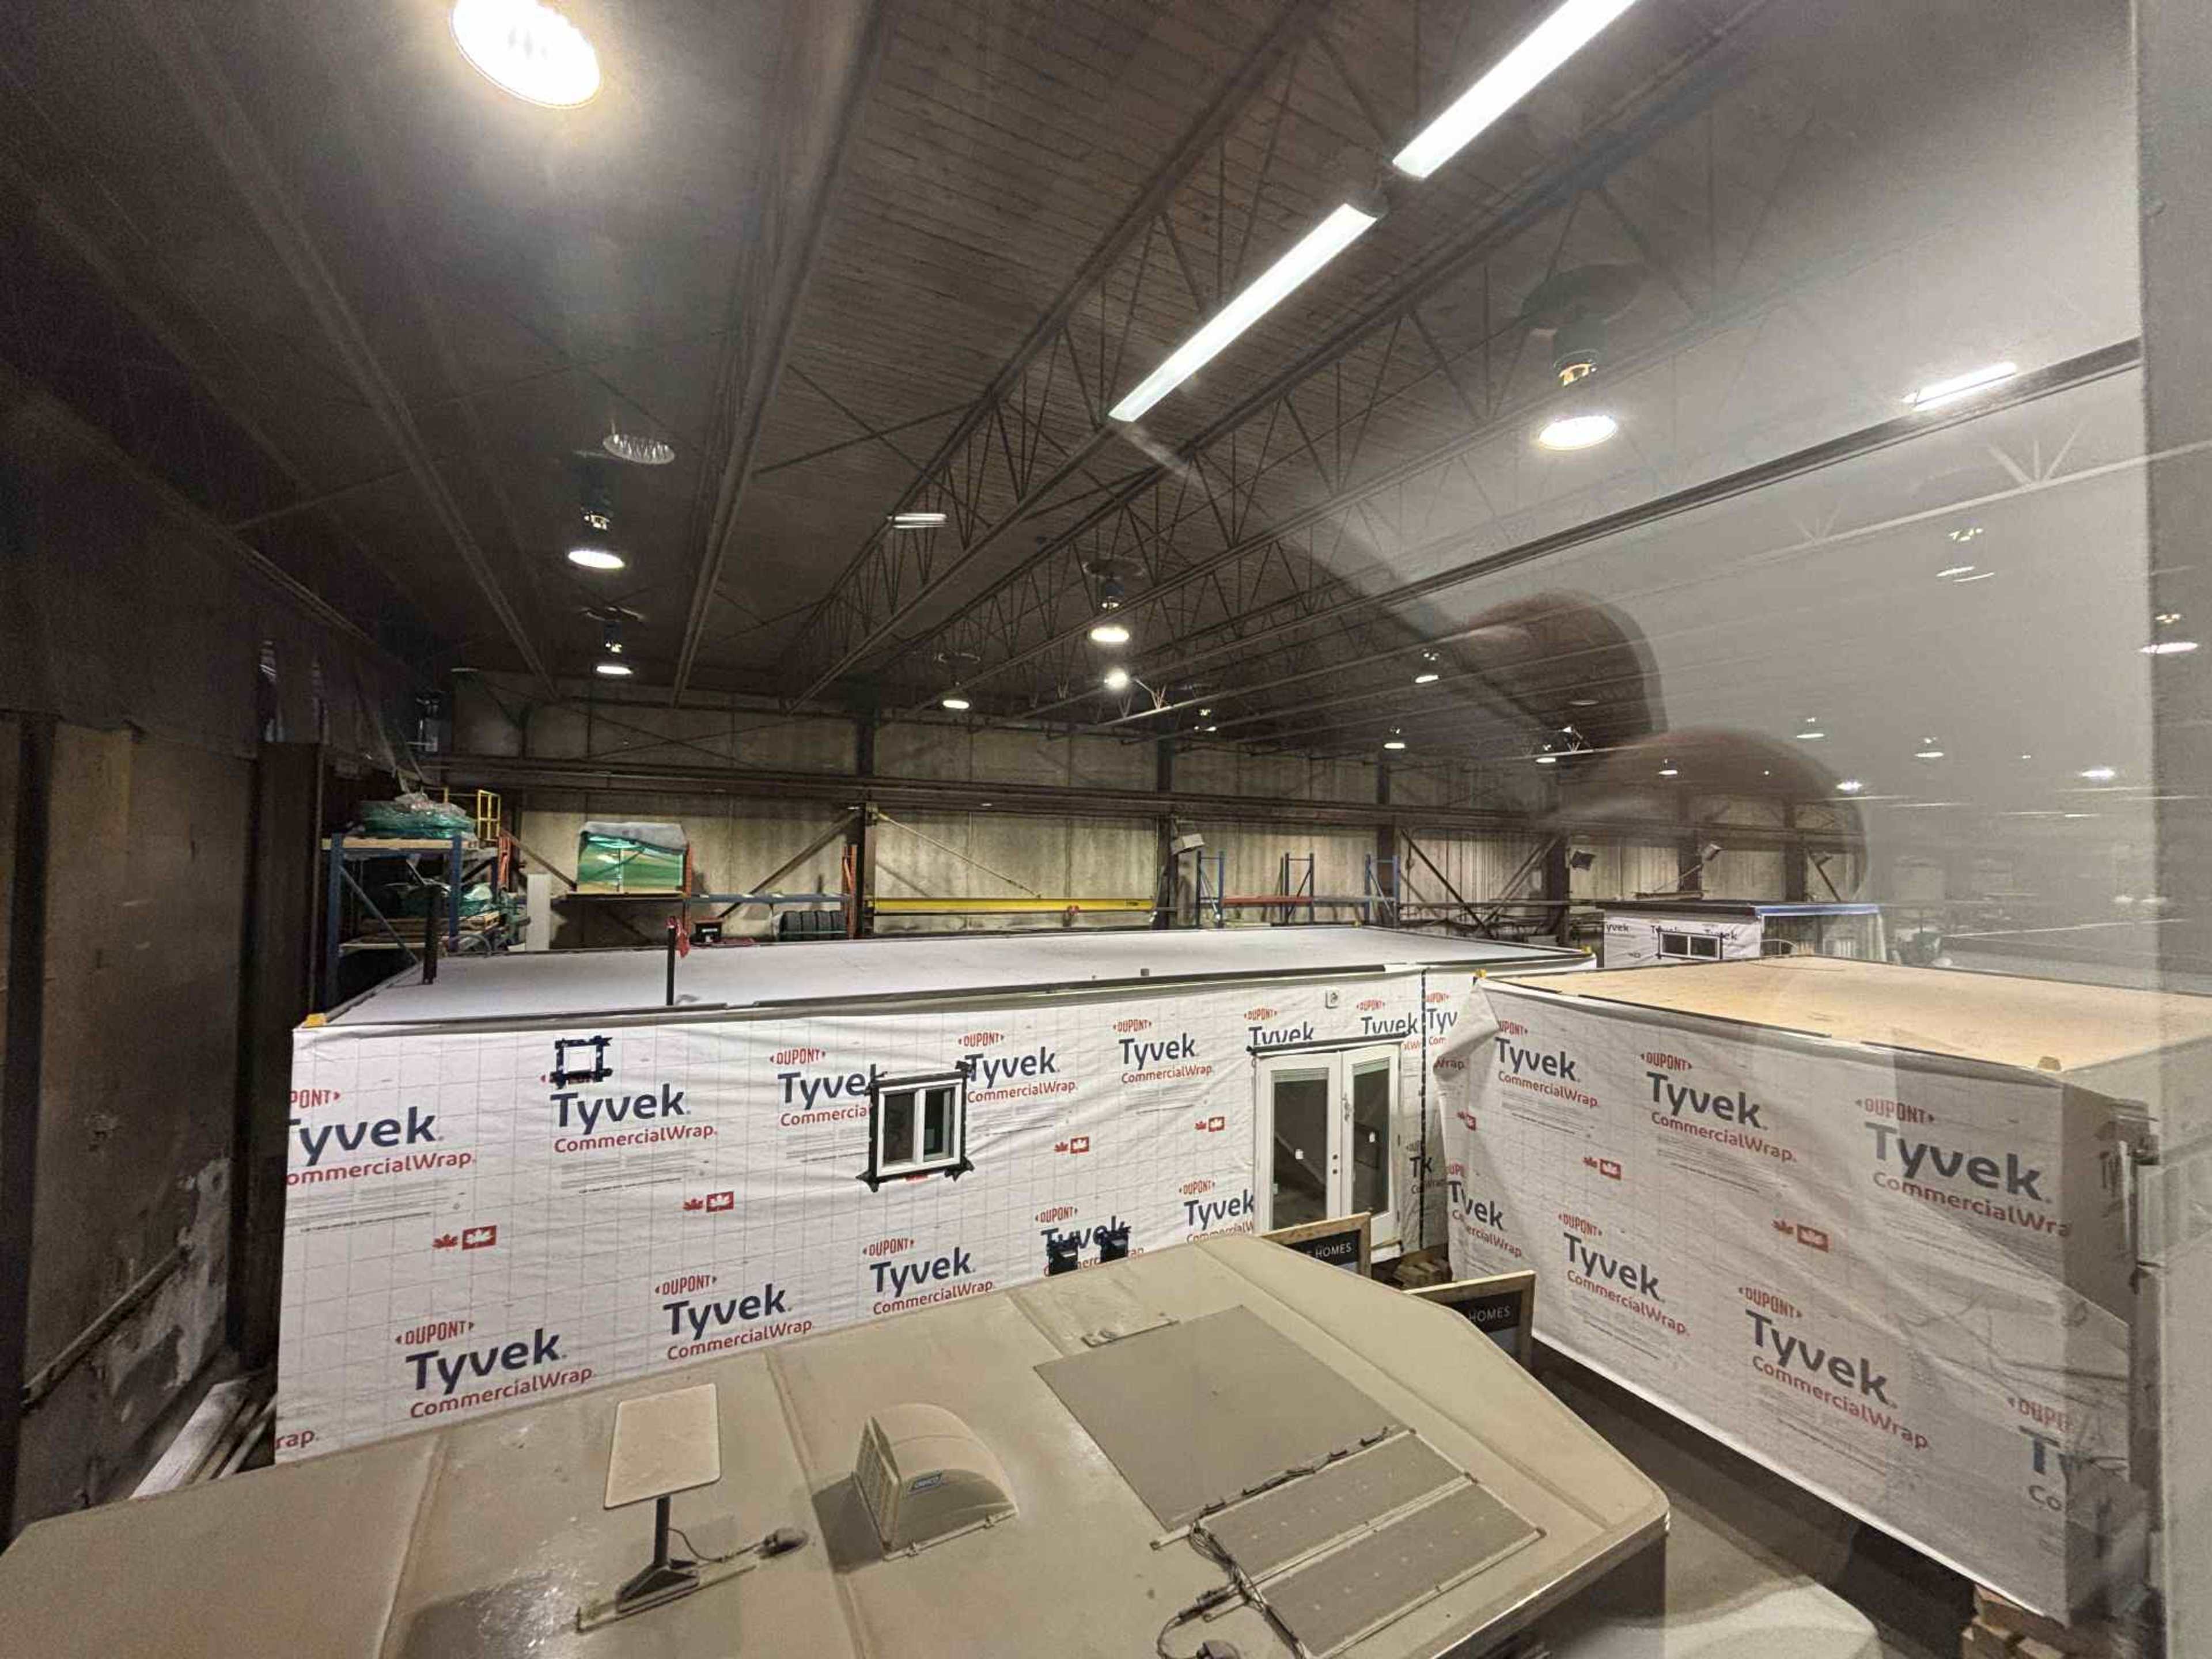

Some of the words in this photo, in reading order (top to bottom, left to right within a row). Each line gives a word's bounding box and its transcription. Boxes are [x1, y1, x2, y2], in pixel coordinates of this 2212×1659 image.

[1118, 1020, 1148, 1032] DUPONT
[1248, 1008, 1273, 1020] DUPONT
[777, 1048, 820, 1065] DUPONT
[964, 1032, 999, 1047] DUPONT
[1119, 1033, 1196, 1070] Tyvek
[965, 1047, 1055, 1089] Tyvek
[1122, 1063, 1212, 1084] CommercialWrap
[1495, 1036, 1576, 1081] Tyvek
[1646, 1052, 1687, 1071] DUPONT
[968, 1081, 1075, 1103] CommercialWrap
[1498, 1071, 1598, 1108] CommercialWrap
[1646, 1071, 1760, 1128] Tyvek
[550, 1084, 685, 1135] Tyvek
[781, 1105, 868, 1127] Commercia
[1865, 1099, 1927, 1124] DUPONT
[554, 1125, 714, 1152] CommercialWrap
[1652, 1112, 1793, 1163] CommercialWrap
[1865, 1122, 2042, 1202] Tyvek
[1183, 1180, 1211, 1195] DUPONT
[1041, 1206, 1073, 1222] DUPONT
[1184, 1189, 1253, 1230] Tyvek
[1563, 1213, 1598, 1236] DUPONT
[869, 1238, 908, 1256] DUPONT
[1315, 1243, 1352, 1258] HOMES
[870, 1247, 971, 1298] Tyvek
[1563, 1232, 1661, 1302] Tyvek
[662, 1275, 710, 1296] DUPONT
[873, 1280, 993, 1316] CommercialWrap
[1567, 1270, 1686, 1336] CommercialWrap
[1745, 1287, 1796, 1318] DUPONT
[663, 1283, 786, 1340] Tyvek
[405, 1321, 467, 1345] DUPONT
[667, 1319, 813, 1361] CommercialWrap
[406, 1328, 560, 1395] Tyvek
[1745, 1309, 1889, 1405] Tyvek
[410, 1369, 592, 1418] CommercialWrap
[1752, 1356, 1929, 1451] CommercialWrap
